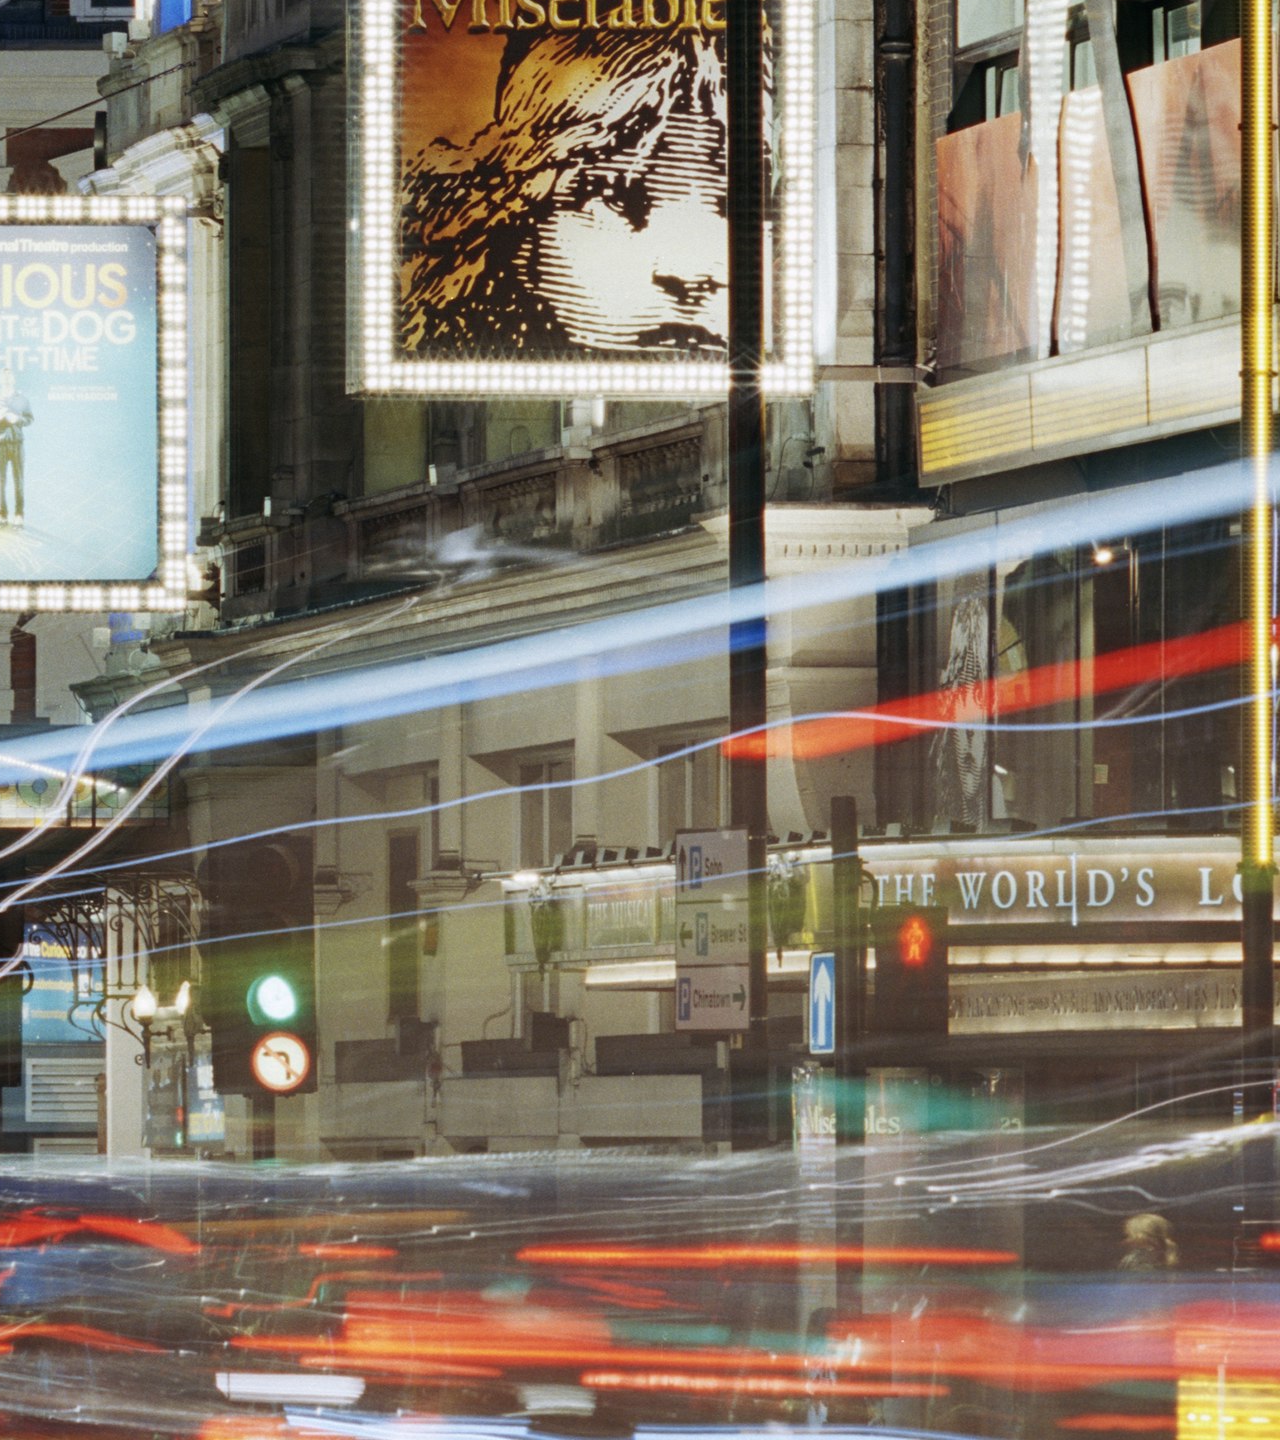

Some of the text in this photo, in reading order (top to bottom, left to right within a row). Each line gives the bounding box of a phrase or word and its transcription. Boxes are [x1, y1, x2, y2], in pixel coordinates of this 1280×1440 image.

[18, 238, 69, 253] Theatre
[70, 241, 128, 255] production
[42, 310, 137, 345] DOG
[704, 857, 723, 876] Soho
[876, 872, 937, 908] THE
[693, 988, 731, 1009] Chinatown
